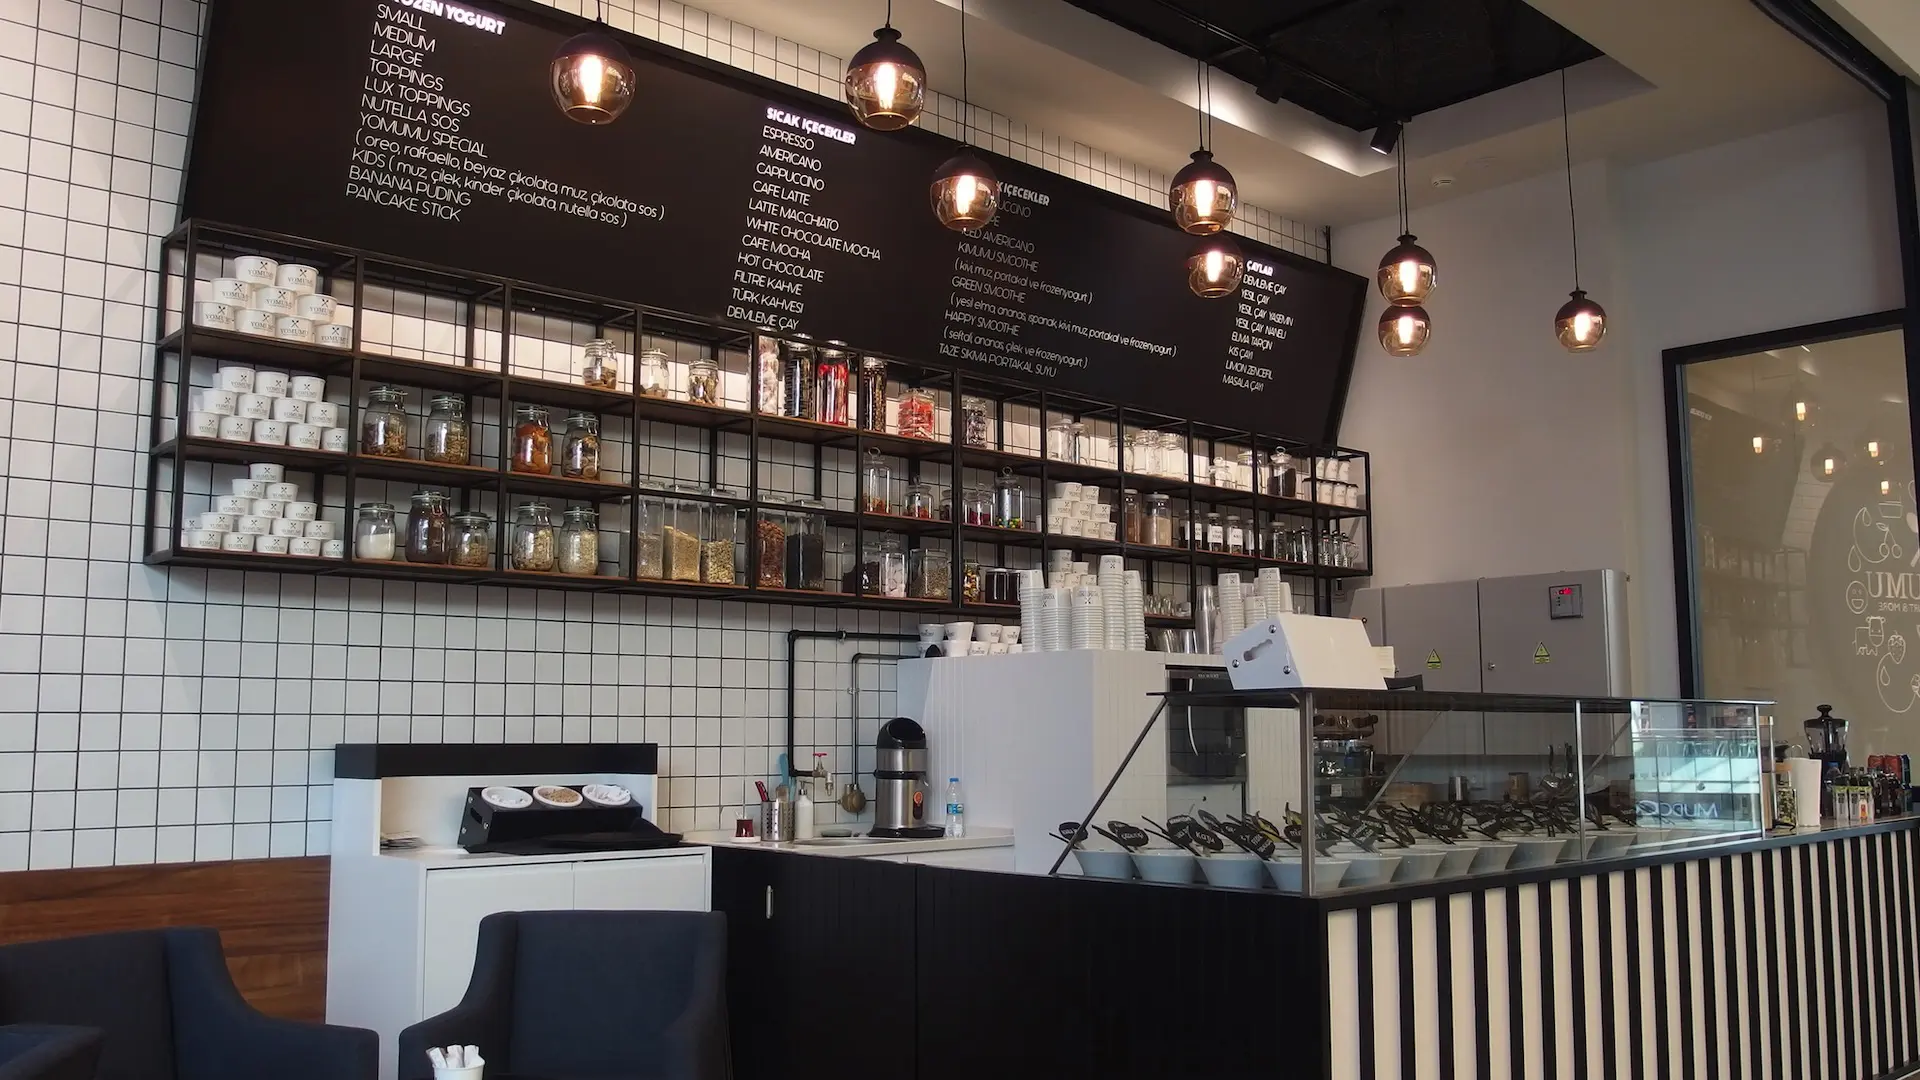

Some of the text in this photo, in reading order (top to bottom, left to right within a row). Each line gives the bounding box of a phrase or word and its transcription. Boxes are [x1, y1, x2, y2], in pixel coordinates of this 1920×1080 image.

[377, 3, 426, 32] SMALL
[446, 5, 505, 35] YOGURT
[373, 21, 435, 52] MEDIUM
[370, 39, 424, 67] LARGE
[370, 57, 444, 91] TOPPINGS
[364, 75, 470, 117] LUX TOPPINGS
[361, 93, 460, 132] NUTELLA SOS
[766, 107, 800, 128] SICAK
[360, 111, 488, 158] YOMUMU SPECIAL
[762, 125, 814, 150] ESPRESSO
[759, 144, 822, 171] AMERICANO
[348, 165, 471, 206] BANANA PUDING
[352, 147, 386, 168] KIDS
[464, 176, 505, 196] kinder
[559, 202, 598, 219] nutella
[600, 211, 619, 224] sos
[463, 157, 506, 180] beyaz
[589, 190, 637, 217] çikolata
[638, 204, 657, 218] sos
[756, 162, 824, 190] CAPPUCCINO
[346, 182, 461, 222] PANCAKE STICK
[752, 180, 810, 206] CAFE LATTE
[748, 197, 839, 231] LATTE MACCHIATO
[742, 234, 810, 261] CAFE MOCHA
[746, 215, 880, 260] WHITE CHOCOLATE MOCHA
[957, 241, 996, 260] KIMUMU
[982, 230, 1034, 254] AMERICANO
[737, 251, 824, 282] HOT CHOCOLATE
[1246, 260, 1273, 276] ÇAYLAR
[732, 287, 760, 304] TÜRK
[734, 269, 803, 295] FILTRE KAHVE
[951, 275, 982, 292] GREEN
[993, 271, 1028, 286] portakal
[1029, 280, 1039, 290] ve
[1040, 281, 1088, 302] frozenyogurt
[1243, 274, 1287, 295] DEMLEME ÇAY
[1256, 293, 1270, 305] ÇAY
[726, 305, 799, 331] DEMLEME ÇAY
[944, 309, 976, 325] HAPPY
[1253, 307, 1267, 319] ÇAY
[1231, 331, 1249, 344] ELMA
[1250, 321, 1264, 333] ÇAY
[1088, 329, 1120, 342] portakal
[1120, 336, 1129, 345] ve
[1129, 336, 1172, 356] frozenyogurt
[939, 342, 960, 357] TAZE
[988, 353, 1033, 373] PORTAKAL
[1035, 363, 1056, 377] SUYU
[1024, 347, 1035, 356] ve
[1035, 347, 1083, 367] frozenyogurt
[1222, 374, 1249, 388] MASALA
